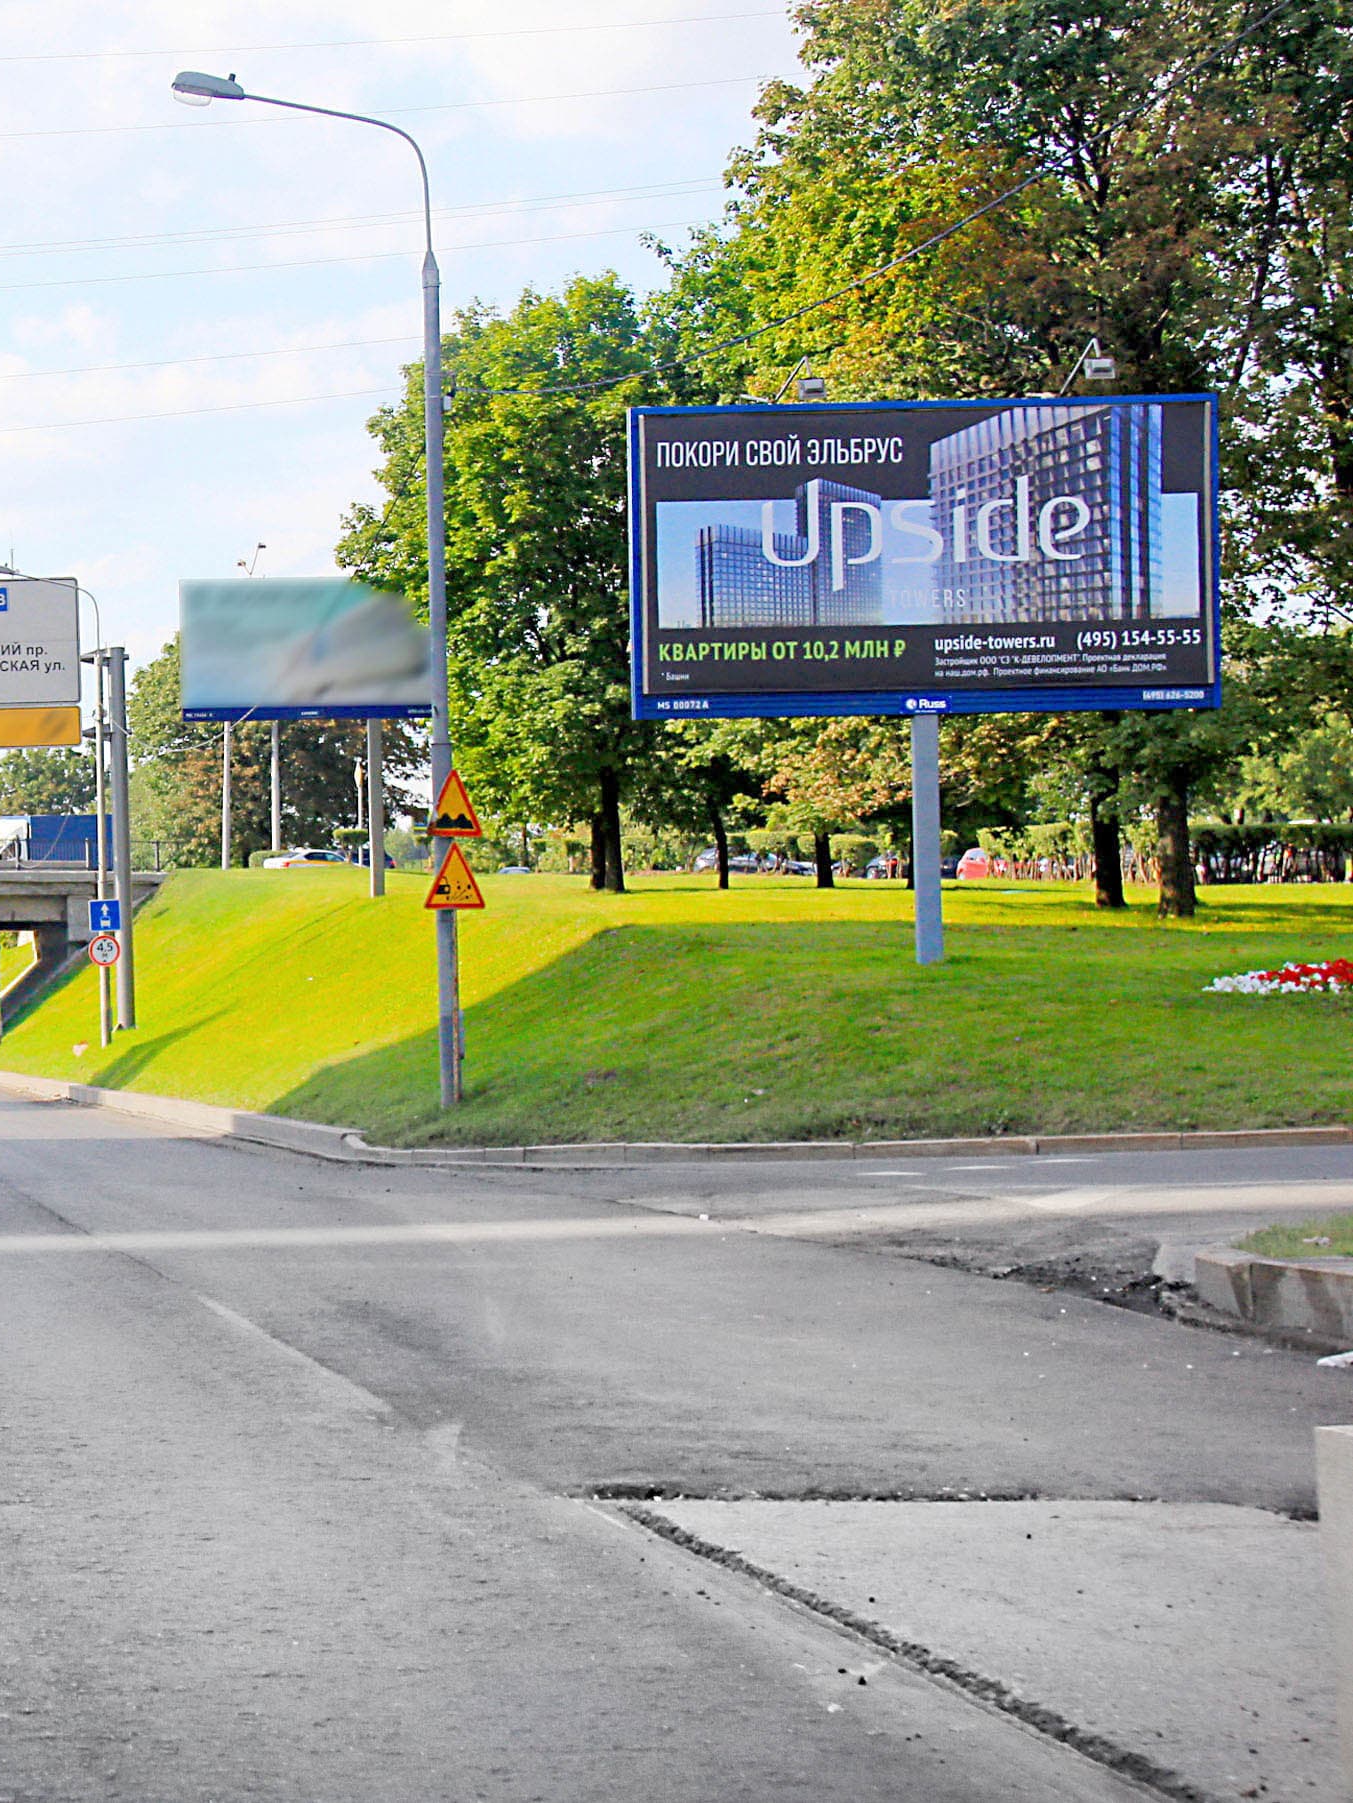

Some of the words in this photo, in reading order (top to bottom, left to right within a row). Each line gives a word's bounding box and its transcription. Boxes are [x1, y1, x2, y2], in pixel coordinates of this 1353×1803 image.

[656, 439, 739, 467] ПОКОРИ
[745, 434, 800, 466] СВОЙ
[806, 436, 903, 464] ЭЛЬБРУС
[762, 476, 1090, 591] Upside
[935, 634, 1056, 654] upside-towers.ru
[1076, 631, 1117, 650] (495)
[1122, 628, 1202, 647] 154-55-55
[26, 645, 48, 659] пр.
[658, 641, 767, 662] КВАРТИРЫ
[772, 640, 798, 660] ОТ
[803, 640, 839, 662] 10,2
[844, 639, 889, 659] МЛН
[43, 661, 66, 674] ул.
[919, 699, 946, 709] Russ
